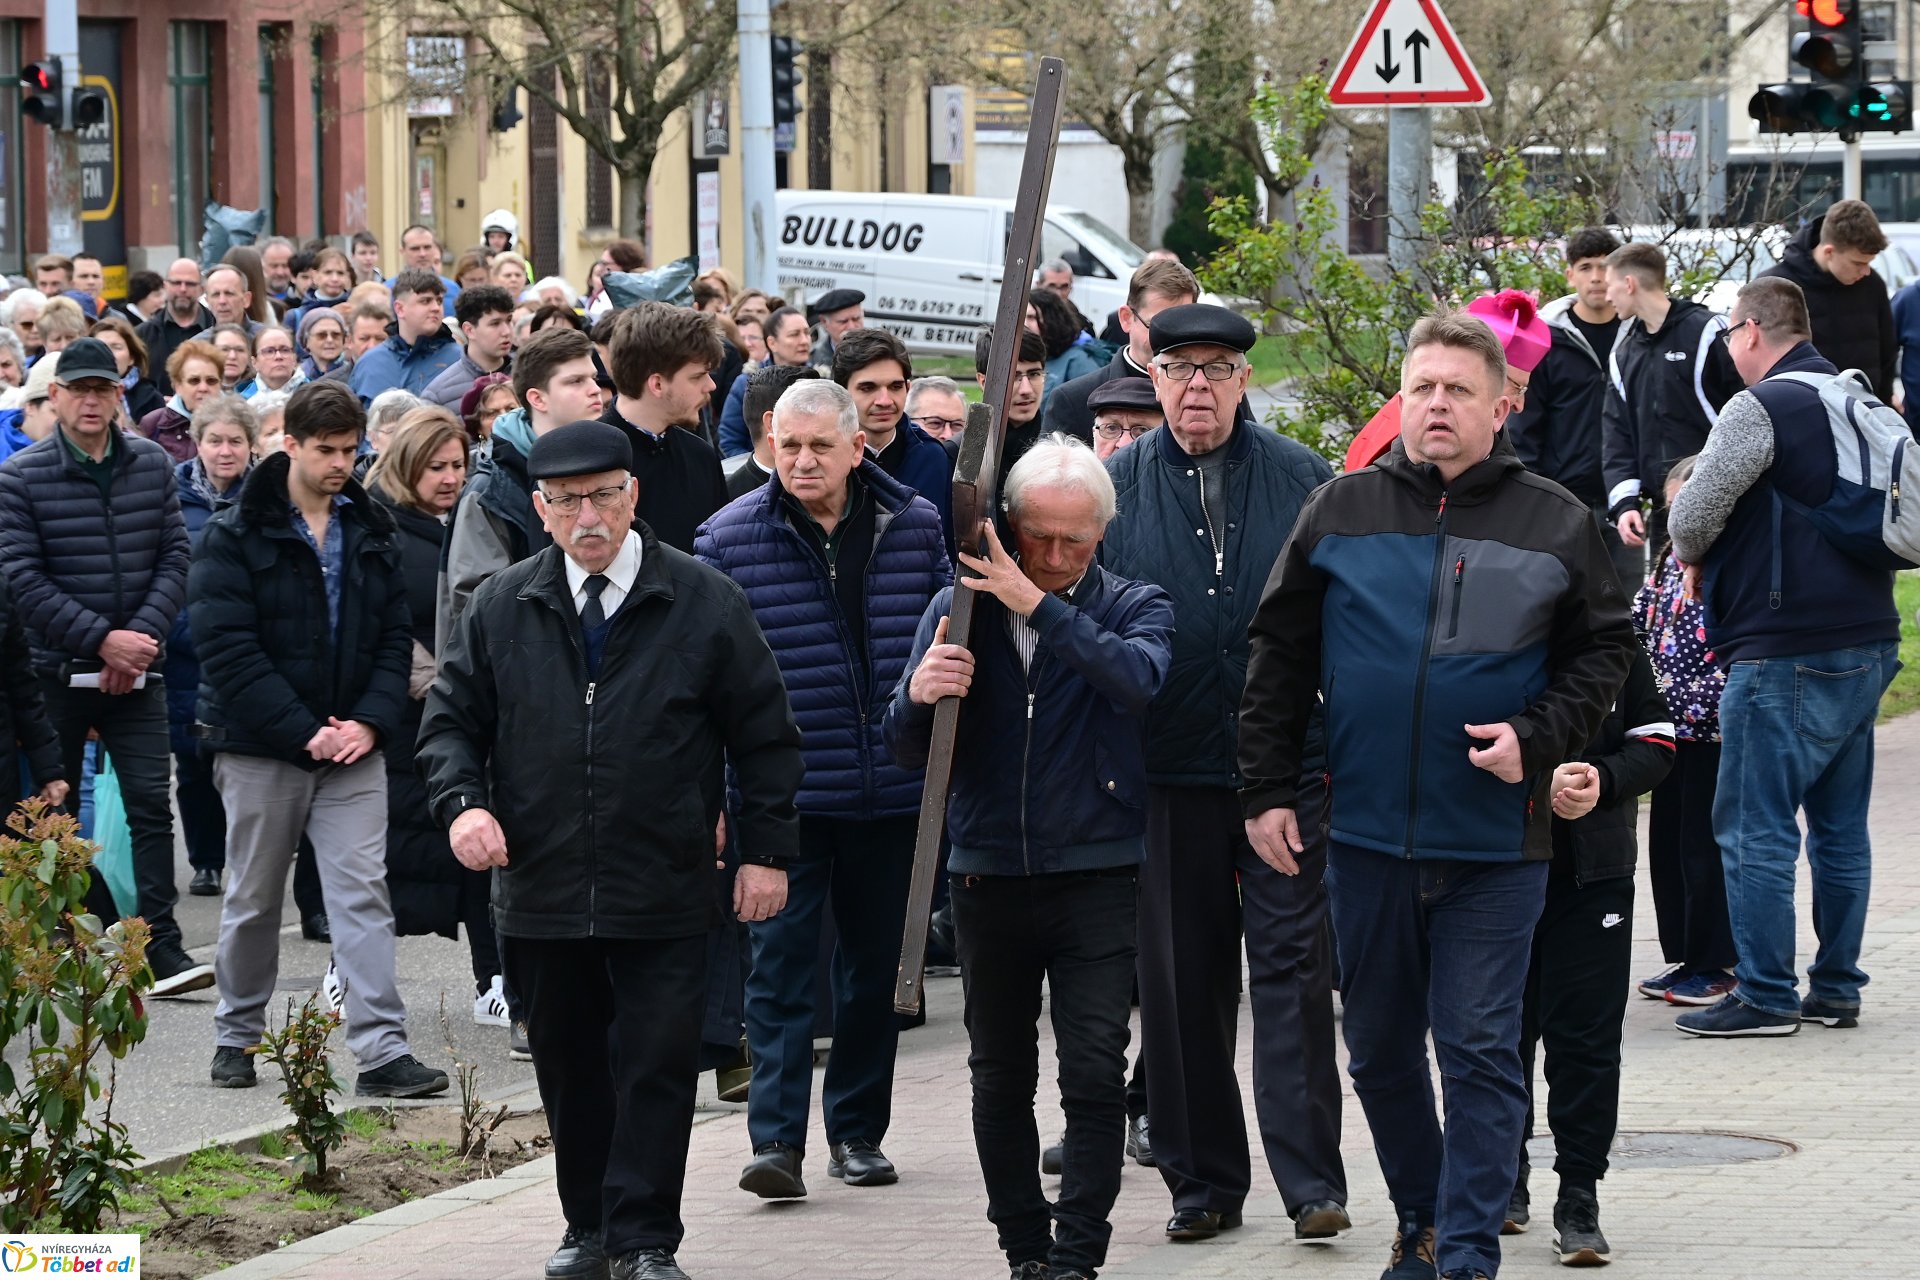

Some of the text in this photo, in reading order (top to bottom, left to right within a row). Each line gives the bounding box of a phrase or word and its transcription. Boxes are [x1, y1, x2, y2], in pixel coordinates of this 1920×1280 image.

[83, 166, 103, 199] FM
[782, 215, 924, 253] BULLDOG
[879, 296, 895, 310] 06
[900, 298, 917, 311] 70
[921, 300, 954, 314] 6767
[925, 327, 975, 344] BETHL
[1605, 913, 1620, 923] NIKE
